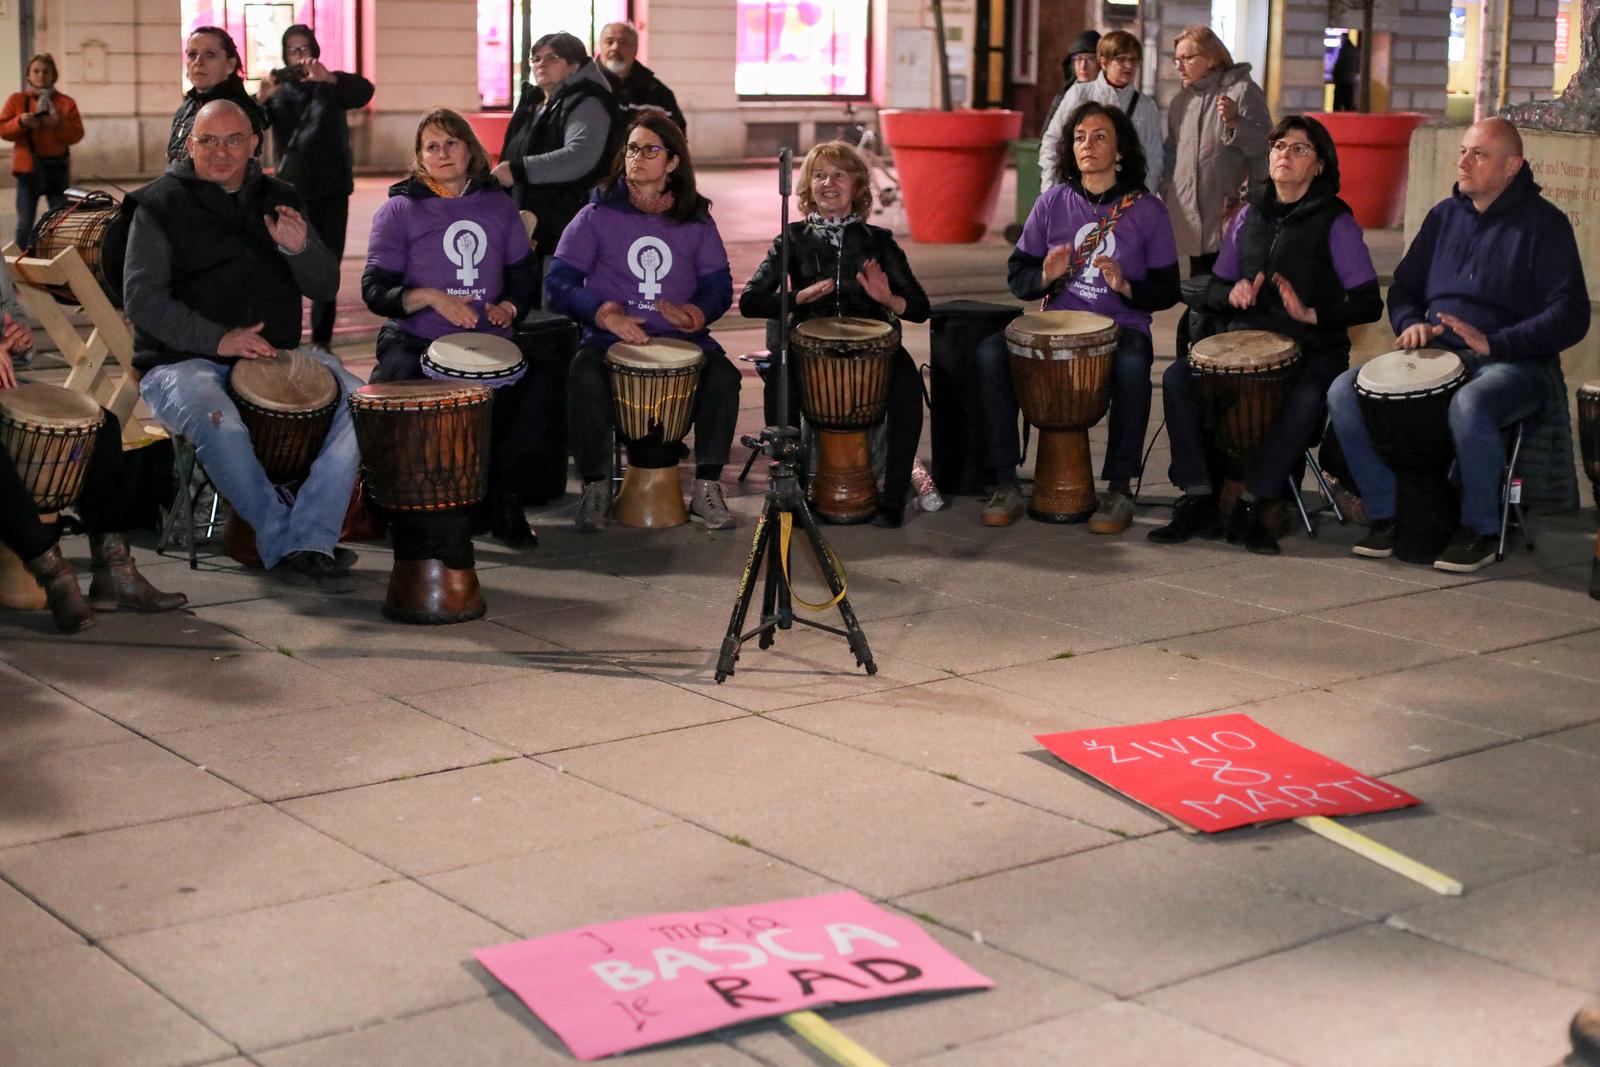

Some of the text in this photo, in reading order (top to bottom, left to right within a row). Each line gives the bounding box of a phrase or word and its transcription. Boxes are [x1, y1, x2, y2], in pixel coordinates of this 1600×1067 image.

[1560, 160, 1586, 178] Nature
[1556, 184, 1580, 203] people
[1081, 730, 1257, 764] ŽIVIO
[1190, 758, 1293, 786] 8.
[1181, 776, 1402, 820] MART!
[650, 915, 787, 941] moja
[590, 923, 900, 992] BASCA
[706, 958, 925, 1009] RAD
